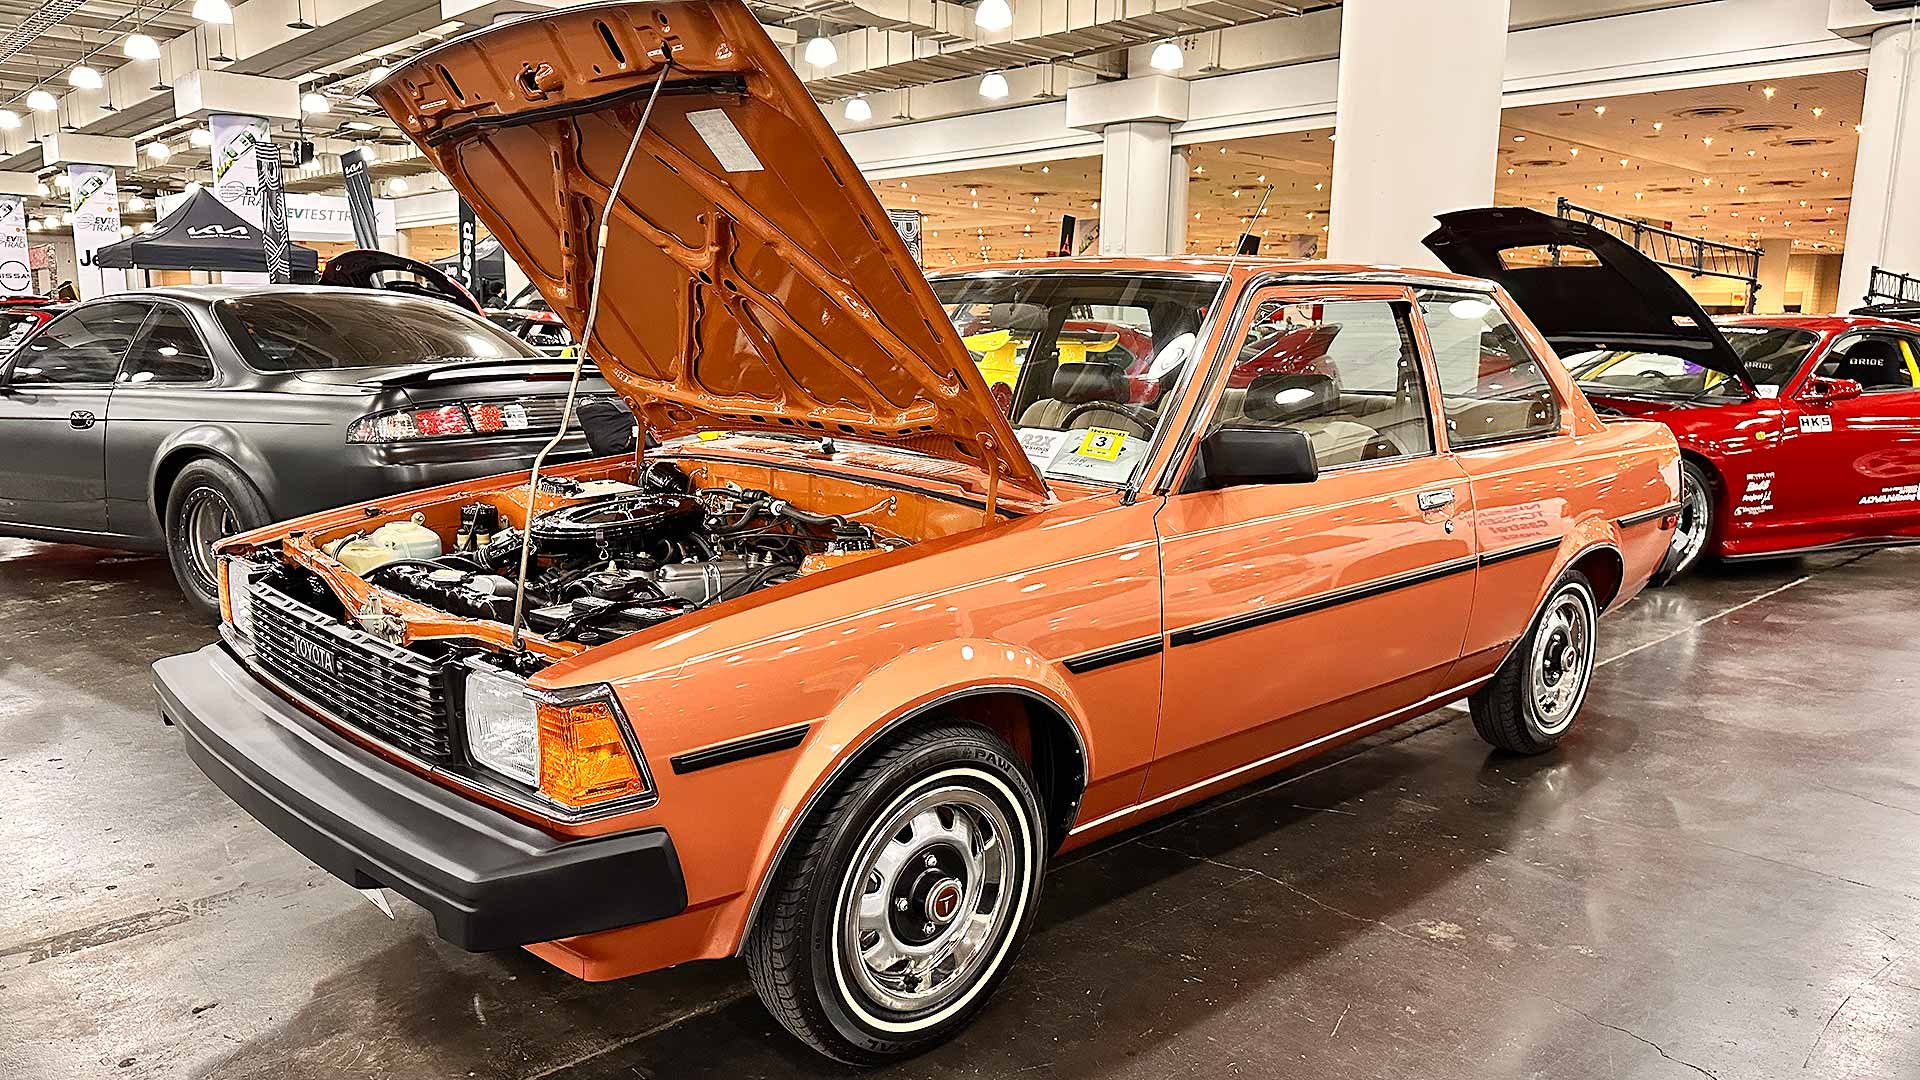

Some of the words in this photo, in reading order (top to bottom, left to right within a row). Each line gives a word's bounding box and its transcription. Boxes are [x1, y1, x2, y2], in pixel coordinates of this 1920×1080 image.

[462, 221, 474, 290] Jeep
[1850, 358, 1885, 367] BRIDE
[1801, 418, 1831, 427] HKS
[1095, 436, 1108, 448] 3
[294, 635, 335, 674] TOYOTA
